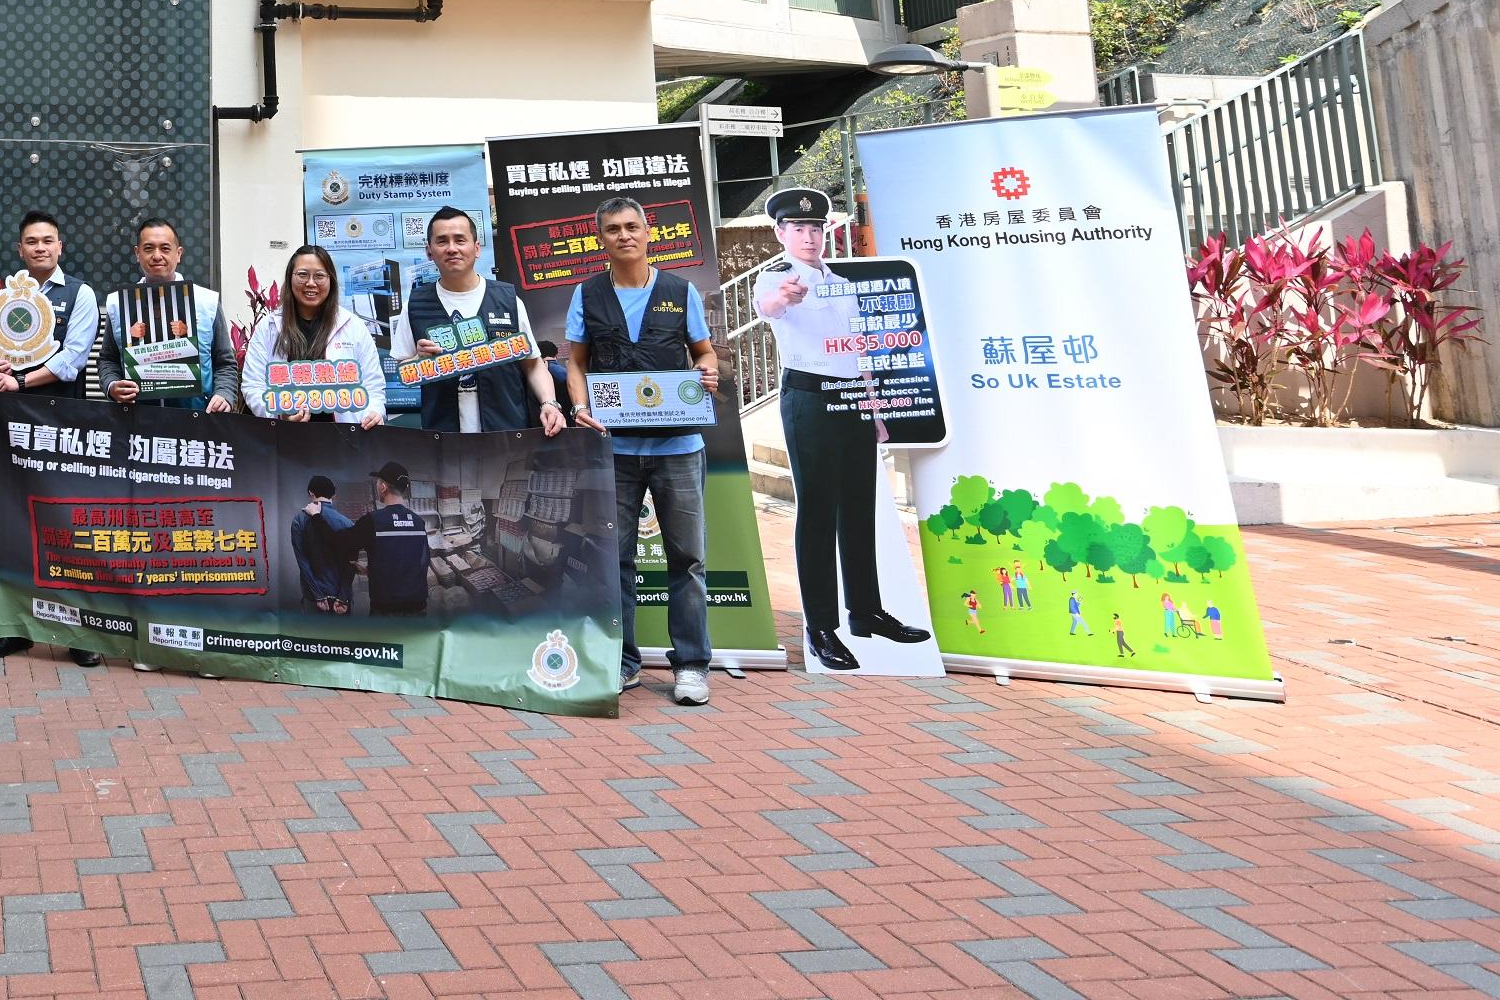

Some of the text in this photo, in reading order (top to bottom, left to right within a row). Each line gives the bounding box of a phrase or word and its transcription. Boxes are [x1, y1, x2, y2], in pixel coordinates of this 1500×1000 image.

[506, 154, 690, 184] 買賣私煙 均屬違法
[358, 190, 451, 200] Duty Stamp System
[508, 186, 538, 197] Buying
[552, 183, 582, 194] selling
[582, 181, 604, 191] illicit
[606, 179, 650, 190] cigarettes
[652, 179, 660, 188] is
[662, 177, 691, 187] illegal
[935, 204, 1102, 229] 香港房屋委員會
[900, 224, 1152, 252] Hong Kong Housing Authority
[534, 268, 572, 282] $2 million
[816, 278, 912, 297] 帶超額煙酒入境
[860, 293, 915, 312] 不報關
[850, 313, 918, 332] 罰款最少
[428, 319, 486, 350] 海關
[824, 330, 922, 354] HK$5,000
[980, 334, 1098, 365] 蘇屋邨
[857, 352, 926, 371] 甚或坐監
[268, 362, 360, 386] 舉報熱線
[821, 375, 929, 390] Undeclared excessive
[971, 372, 1122, 389] So Uk Estate
[264, 388, 368, 411] 1828080
[840, 390, 868, 400] liquor
[881, 387, 919, 396] tobacco
[826, 403, 848, 412] from
[915, 396, 934, 404] fine
[861, 408, 936, 420] to imprisonment
[7, 420, 235, 471] 買賣私煙 均屬違法
[12, 454, 232, 489] Buying or selling illicit cigarettes is illegal
[49, 566, 62, 577] $2
[63, 568, 94, 580] million
[136, 572, 144, 582] 7
[146, 572, 178, 585] years'
[181, 570, 256, 583] imprisonment
[83, 615, 133, 632] 182 8080
[152, 626, 201, 640] 舉報電郵
[206, 634, 398, 661] crimereport@customs.gov.hk
